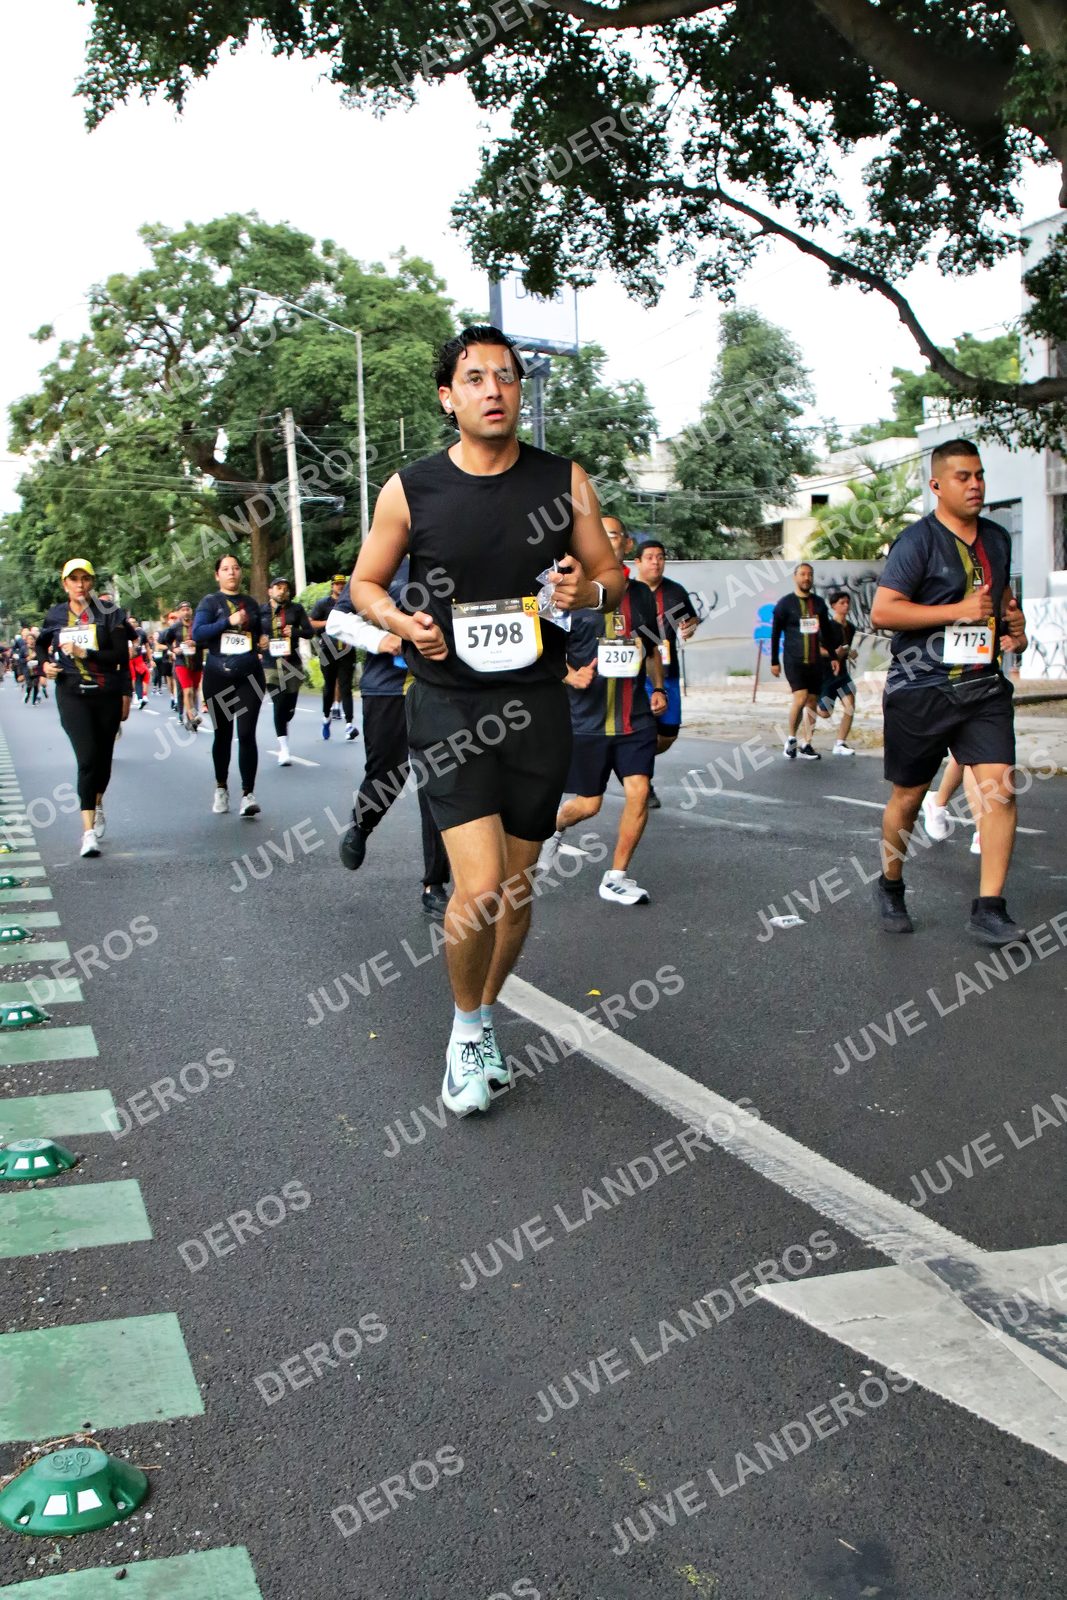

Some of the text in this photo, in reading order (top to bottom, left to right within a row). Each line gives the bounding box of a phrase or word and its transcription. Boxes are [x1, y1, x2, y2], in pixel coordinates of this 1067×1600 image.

[67, 634, 89, 644] 505
[467, 621, 524, 649] 5798
[953, 632, 987, 647] 7175
[605, 650, 635, 663] 2307
